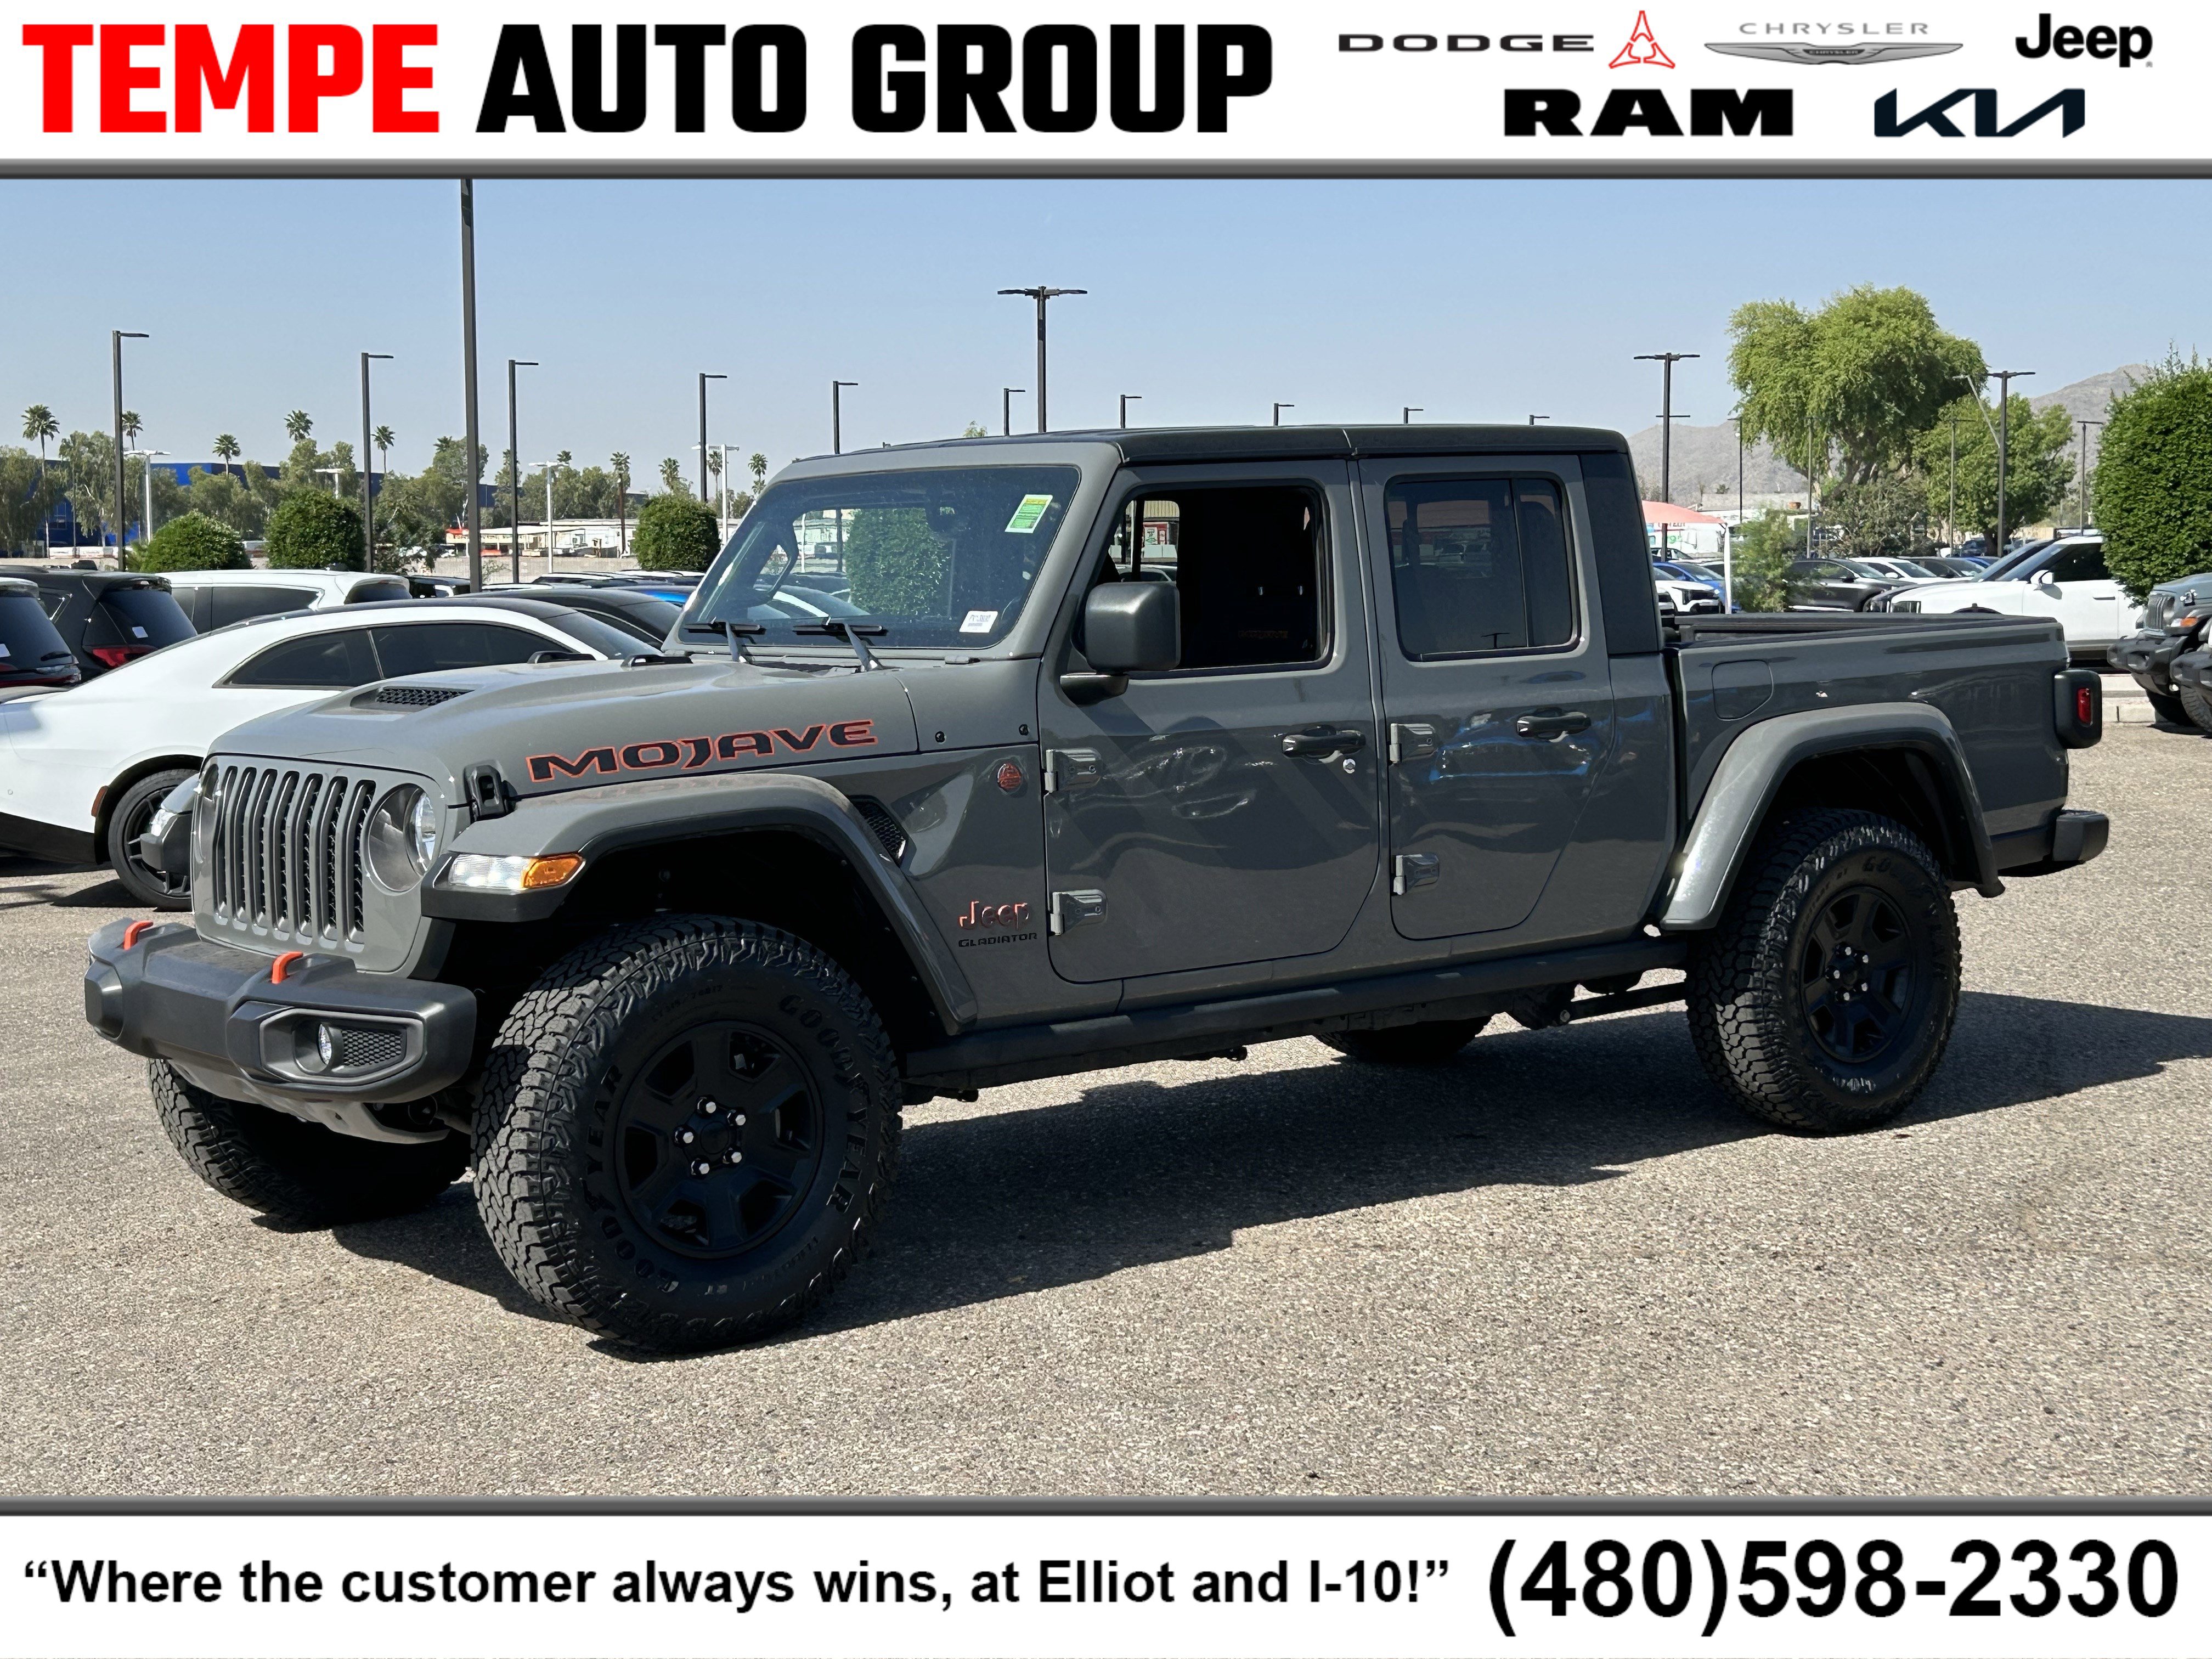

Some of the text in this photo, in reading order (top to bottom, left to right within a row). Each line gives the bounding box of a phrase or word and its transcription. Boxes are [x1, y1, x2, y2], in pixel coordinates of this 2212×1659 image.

[526, 719, 878, 783] MOJAVE
[959, 900, 1029, 930] Jeep
[958, 933, 1037, 947] GLADIATOR
